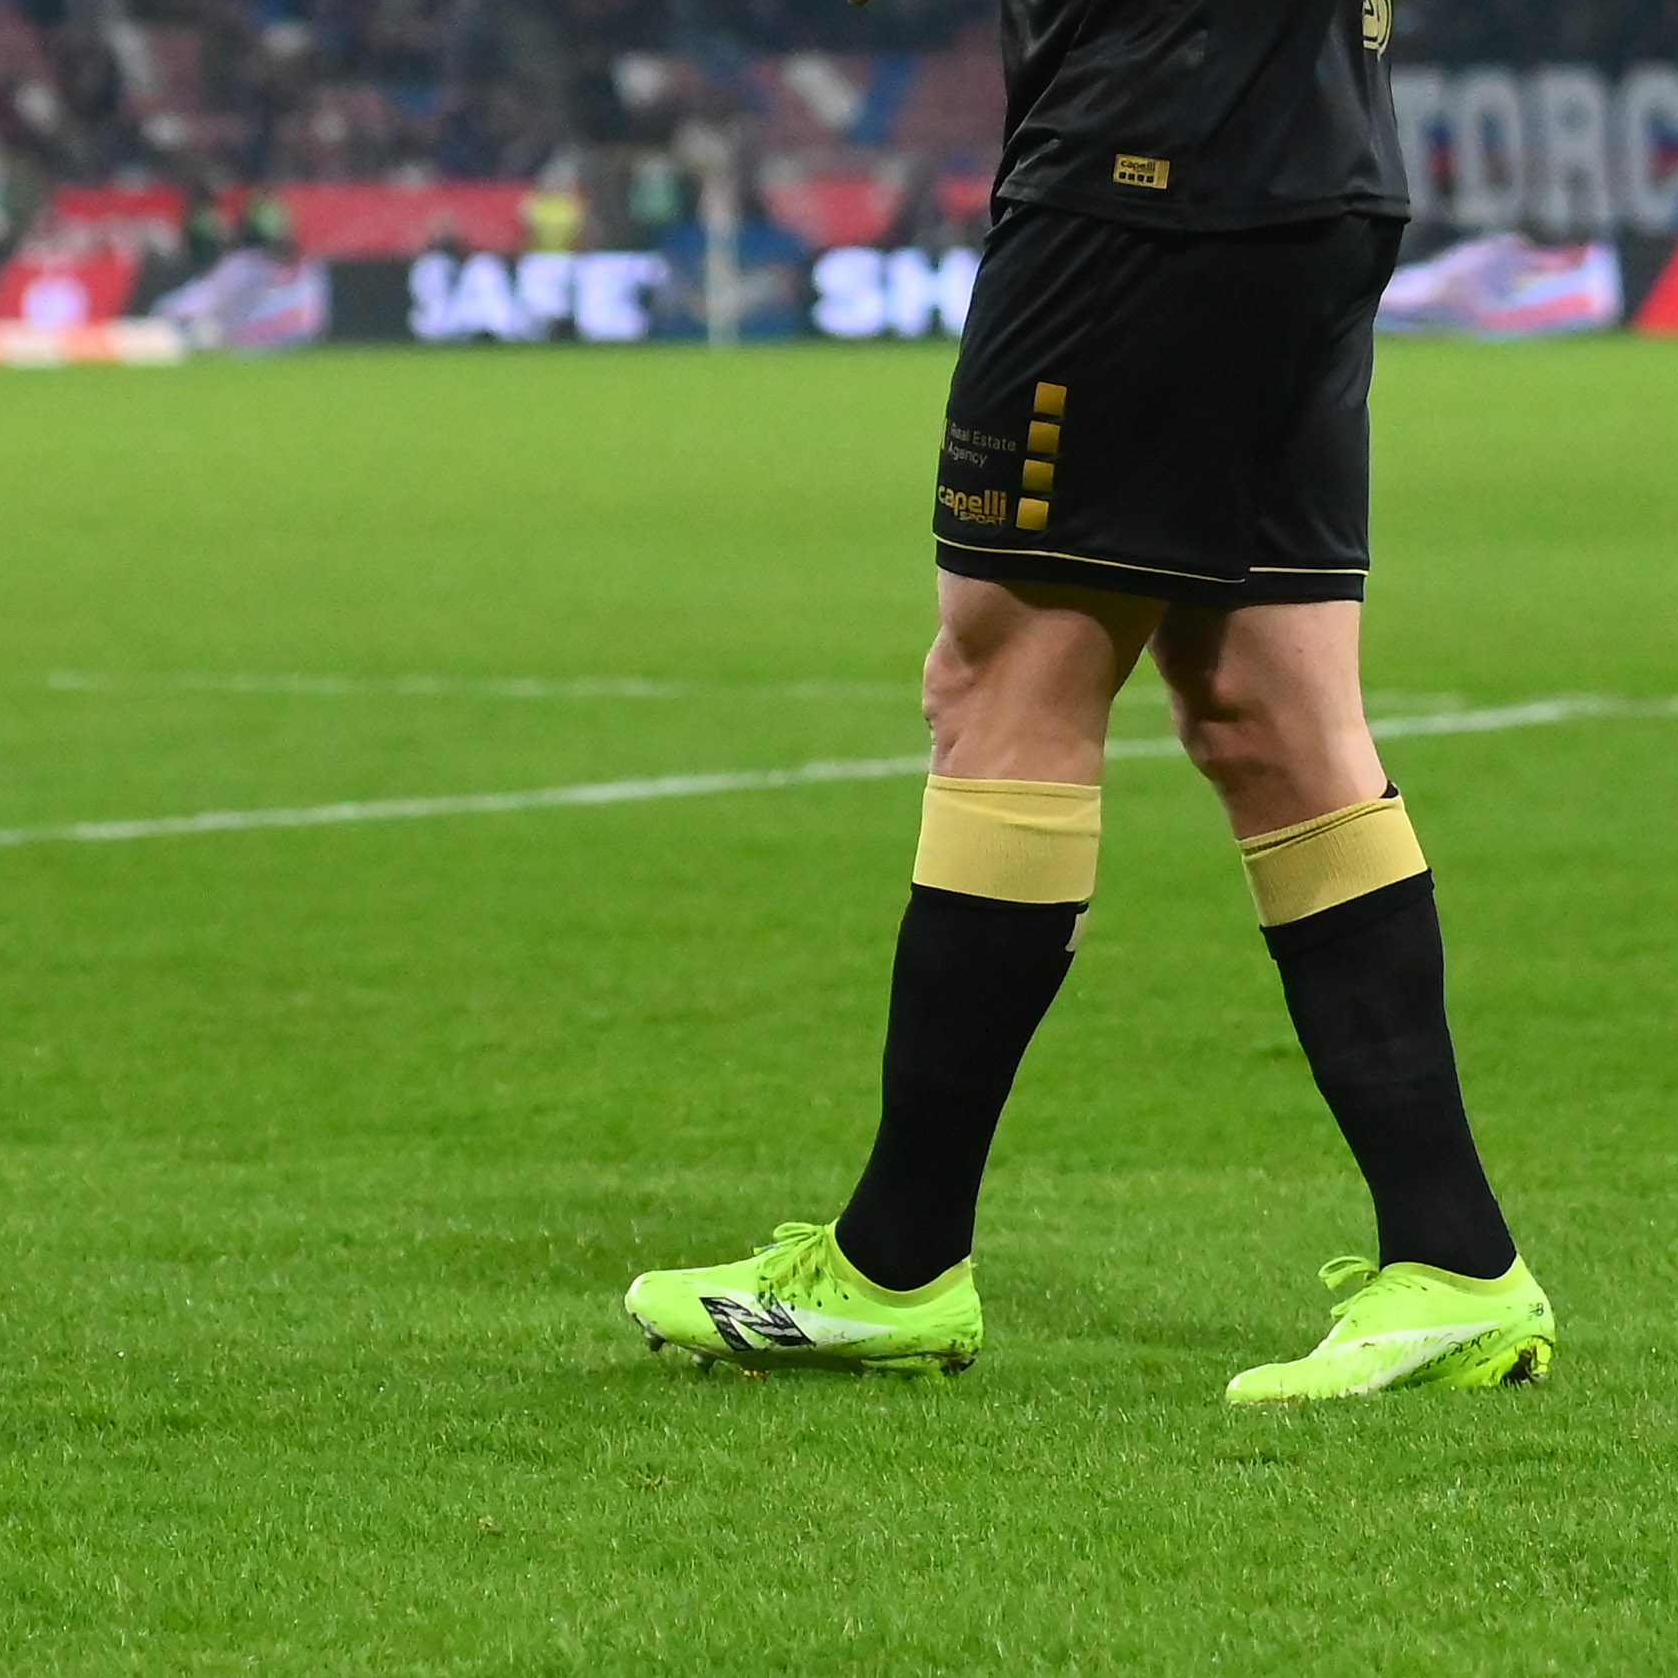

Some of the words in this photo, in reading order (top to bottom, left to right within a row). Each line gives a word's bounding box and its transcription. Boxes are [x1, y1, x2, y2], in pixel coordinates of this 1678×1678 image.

[972, 430, 1017, 452] Estate
[947, 441, 987, 468] Agency
[938, 485, 1007, 517] capelli
[959, 511, 1006, 525] SPORT
